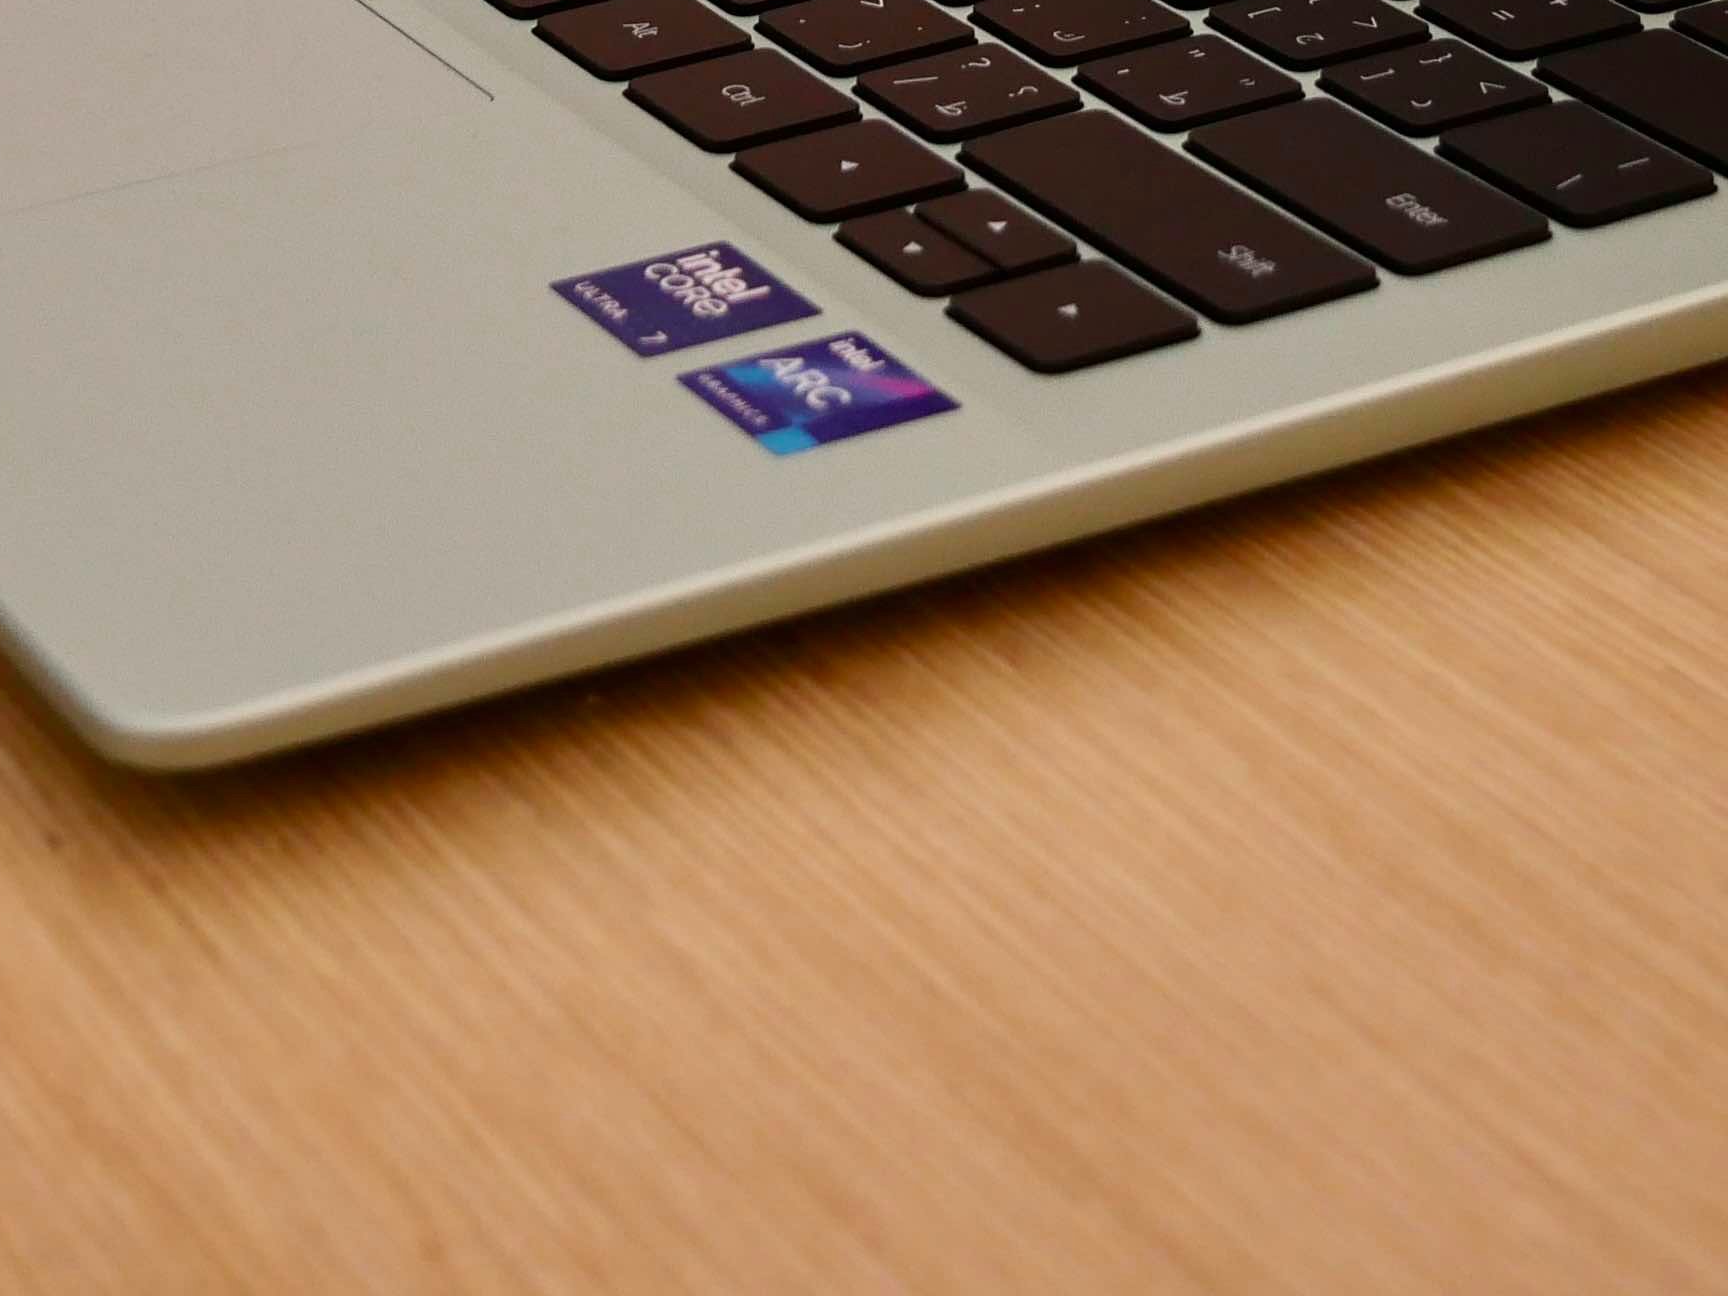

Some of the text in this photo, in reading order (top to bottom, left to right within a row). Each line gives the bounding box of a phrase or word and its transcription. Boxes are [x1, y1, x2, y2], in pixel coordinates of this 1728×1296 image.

[622, 22, 658, 39] Alt
[721, 84, 765, 107] Ctrl
[1385, 192, 1448, 226] Enter
[676, 249, 772, 305] intel
[573, 280, 628, 322] ULTRA
[829, 337, 887, 373] intel
[759, 355, 853, 411] ARC
